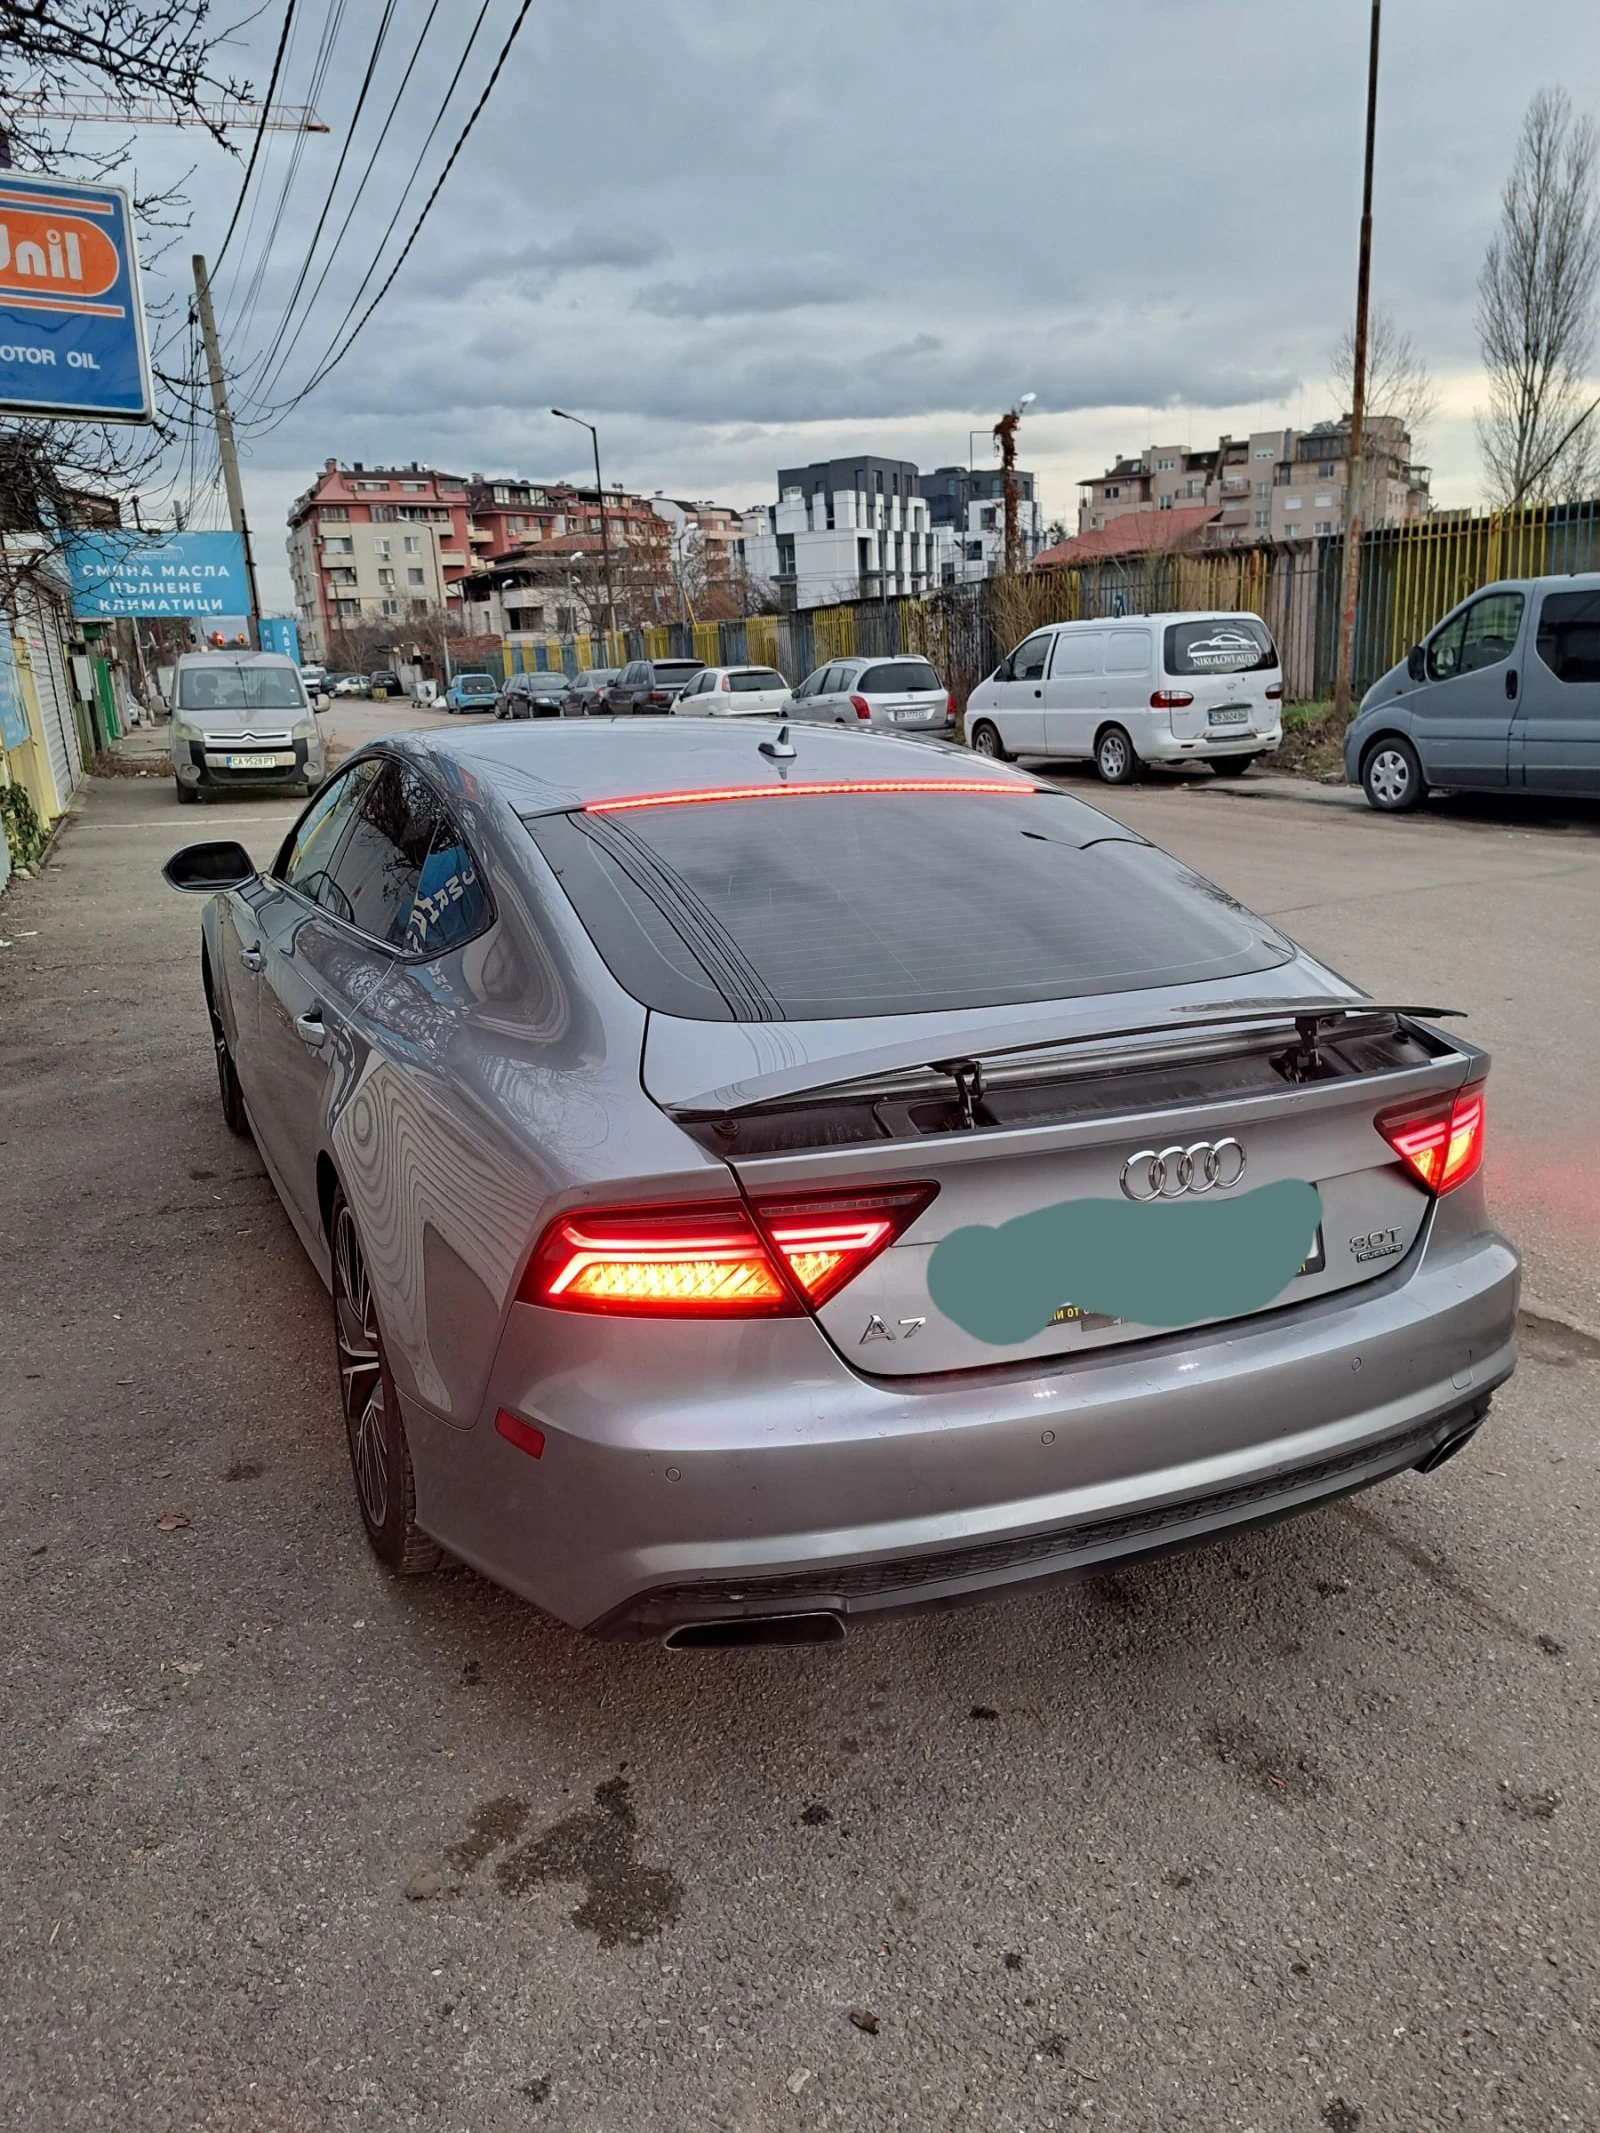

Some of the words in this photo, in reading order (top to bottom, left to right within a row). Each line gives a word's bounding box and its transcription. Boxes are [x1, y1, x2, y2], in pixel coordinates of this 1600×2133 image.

[66, 351, 100, 370] OIL
[82, 565, 153, 577] СМЯНА
[161, 565, 230, 577] МАСЛА
[109, 582, 203, 594] ПЪЛНЕНЕ
[99, 599, 223, 612] КЛИМАТИЦИ
[1193, 654, 1236, 667] NIKOLOVI
[1237, 653, 1259, 664] AUTO
[1360, 1245, 1402, 1262] quattro
[859, 1314, 926, 1345] A7
